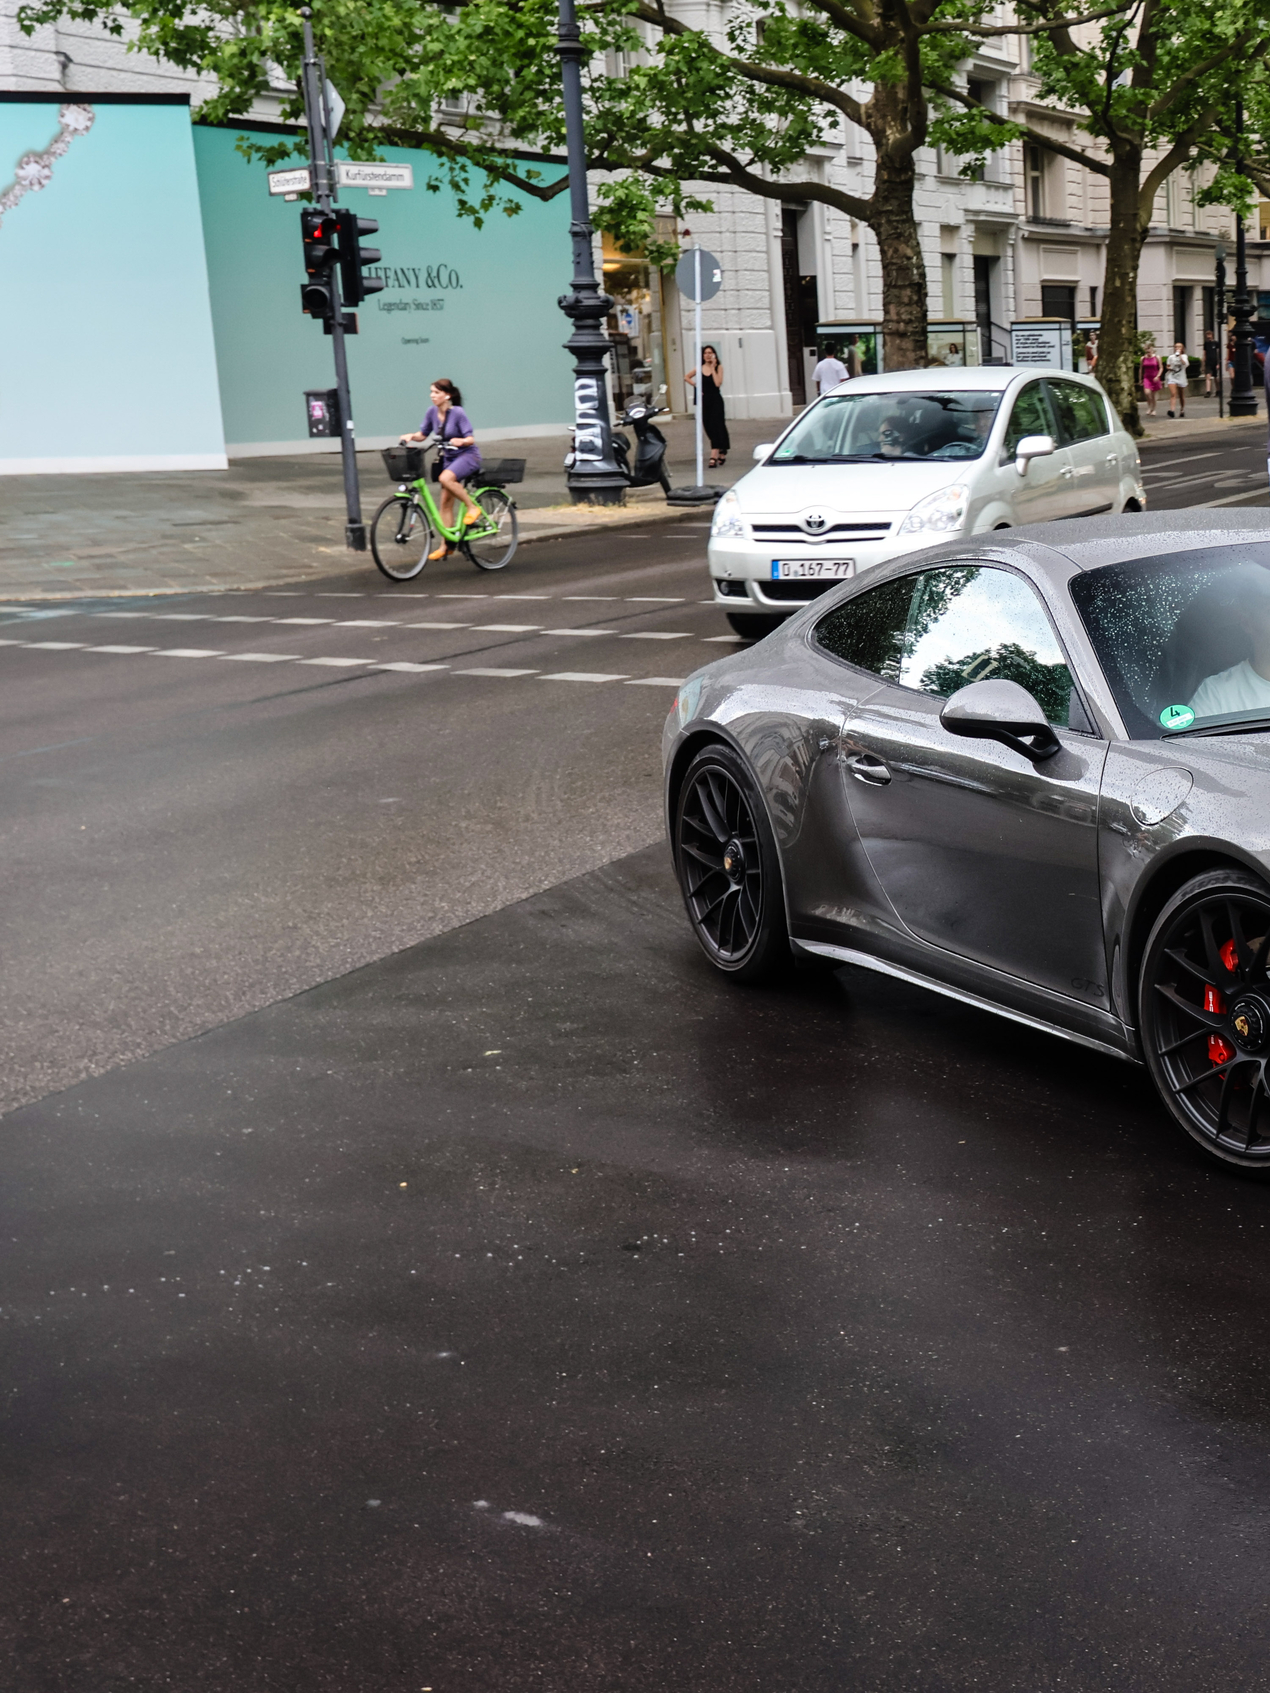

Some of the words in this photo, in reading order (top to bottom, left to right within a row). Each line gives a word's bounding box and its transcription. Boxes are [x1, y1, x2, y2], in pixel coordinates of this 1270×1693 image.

[346, 169, 405, 182] Kurfürstendamm
[799, 562, 850, 576] 167-77
[1170, 706, 1181, 717] 4
[1071, 977, 1104, 998] GTS
